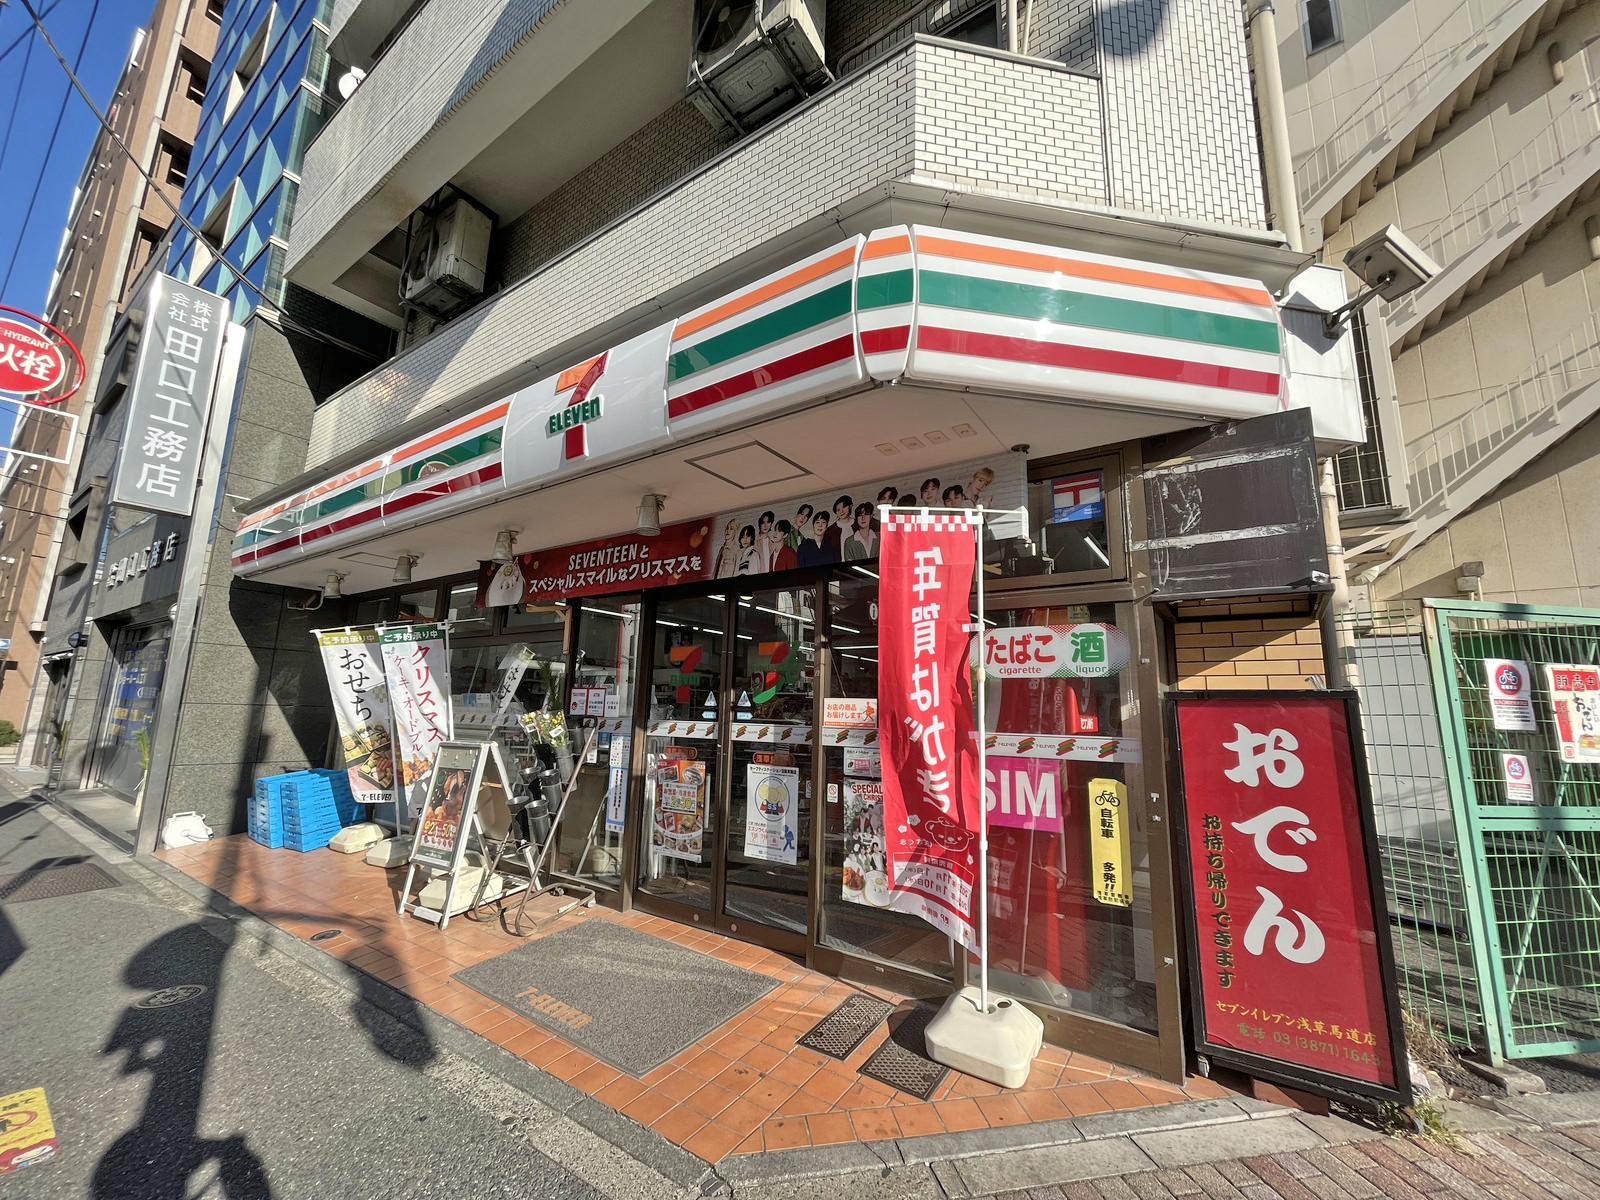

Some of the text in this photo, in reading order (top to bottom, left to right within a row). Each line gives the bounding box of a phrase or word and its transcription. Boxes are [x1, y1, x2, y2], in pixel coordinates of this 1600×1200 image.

[168, 291, 213, 332] 株式 会社
[3, 329, 51, 350] HYDRANT
[0, 342, 56, 382] 火栓
[136, 325, 204, 498] 田口工務店
[321, 634, 375, 645] ご予約承り中
[384, 630, 438, 642] ご予約承り中
[985, 631, 1105, 665] たばこ 酒
[340, 648, 372, 721] おせち
[999, 664, 1107, 676] cigarette liquor
[412, 645, 444, 743] クリスマス
[826, 703, 857, 712] お店の商品
[826, 711, 862, 719] お届けします
[852, 784, 884, 794] SPECIAL
[1100, 807, 1114, 839] 自転車
[1221, 722, 1326, 964] おでん
[1201, 813, 1236, 989] お持ち帰りできます
[1216, 1000, 1377, 1047] セブンイレブン浅草馬道店
[1237, 1022, 1265, 1040] 電話
[1273, 1030, 1291, 1045] 03
[1295, 1036, 1340, 1057] (3871)
